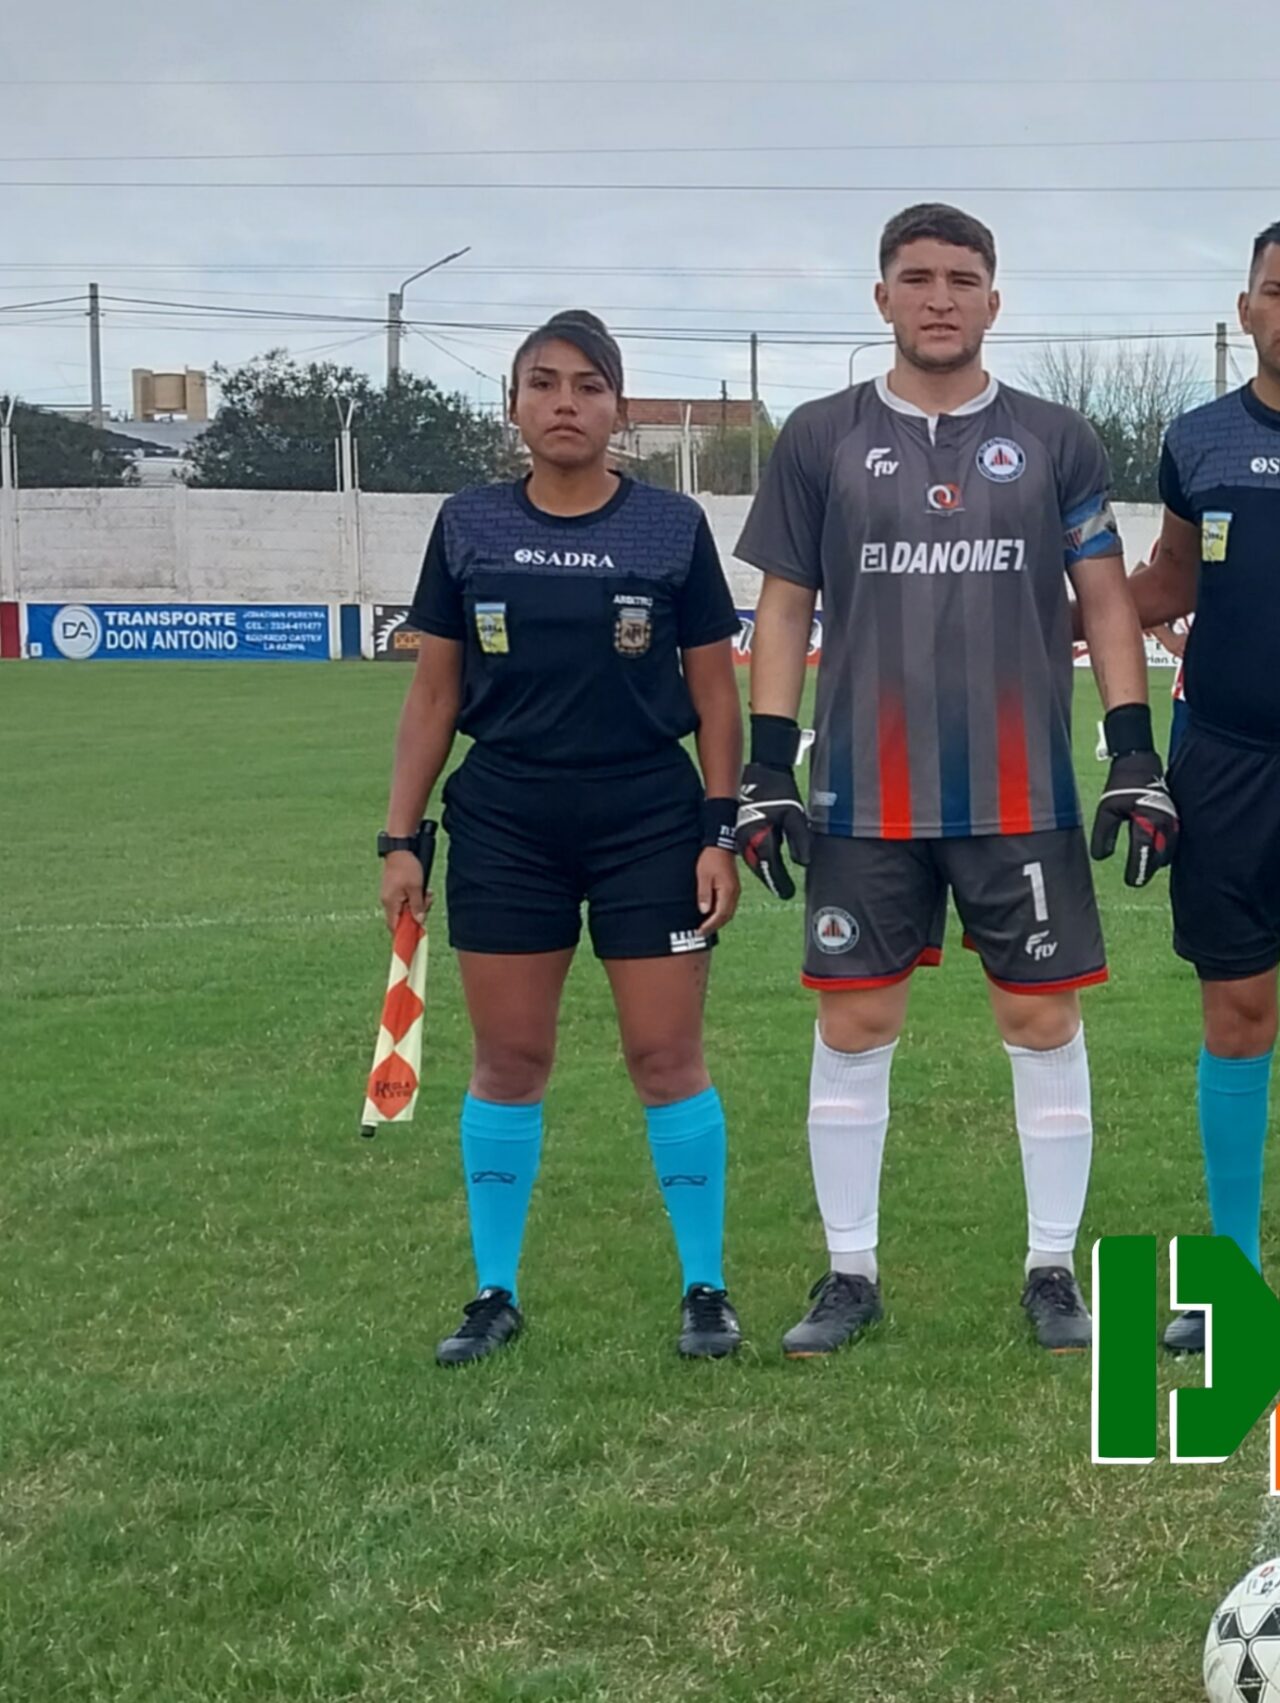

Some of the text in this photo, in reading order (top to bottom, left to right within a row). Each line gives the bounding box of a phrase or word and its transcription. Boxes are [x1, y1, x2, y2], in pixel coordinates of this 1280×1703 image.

[532, 549, 615, 569] SADRA
[104, 612, 236, 627] TRANSPORTE
[106, 629, 238, 650] DON ANTONIO
[1023, 862, 1048, 922] 1
